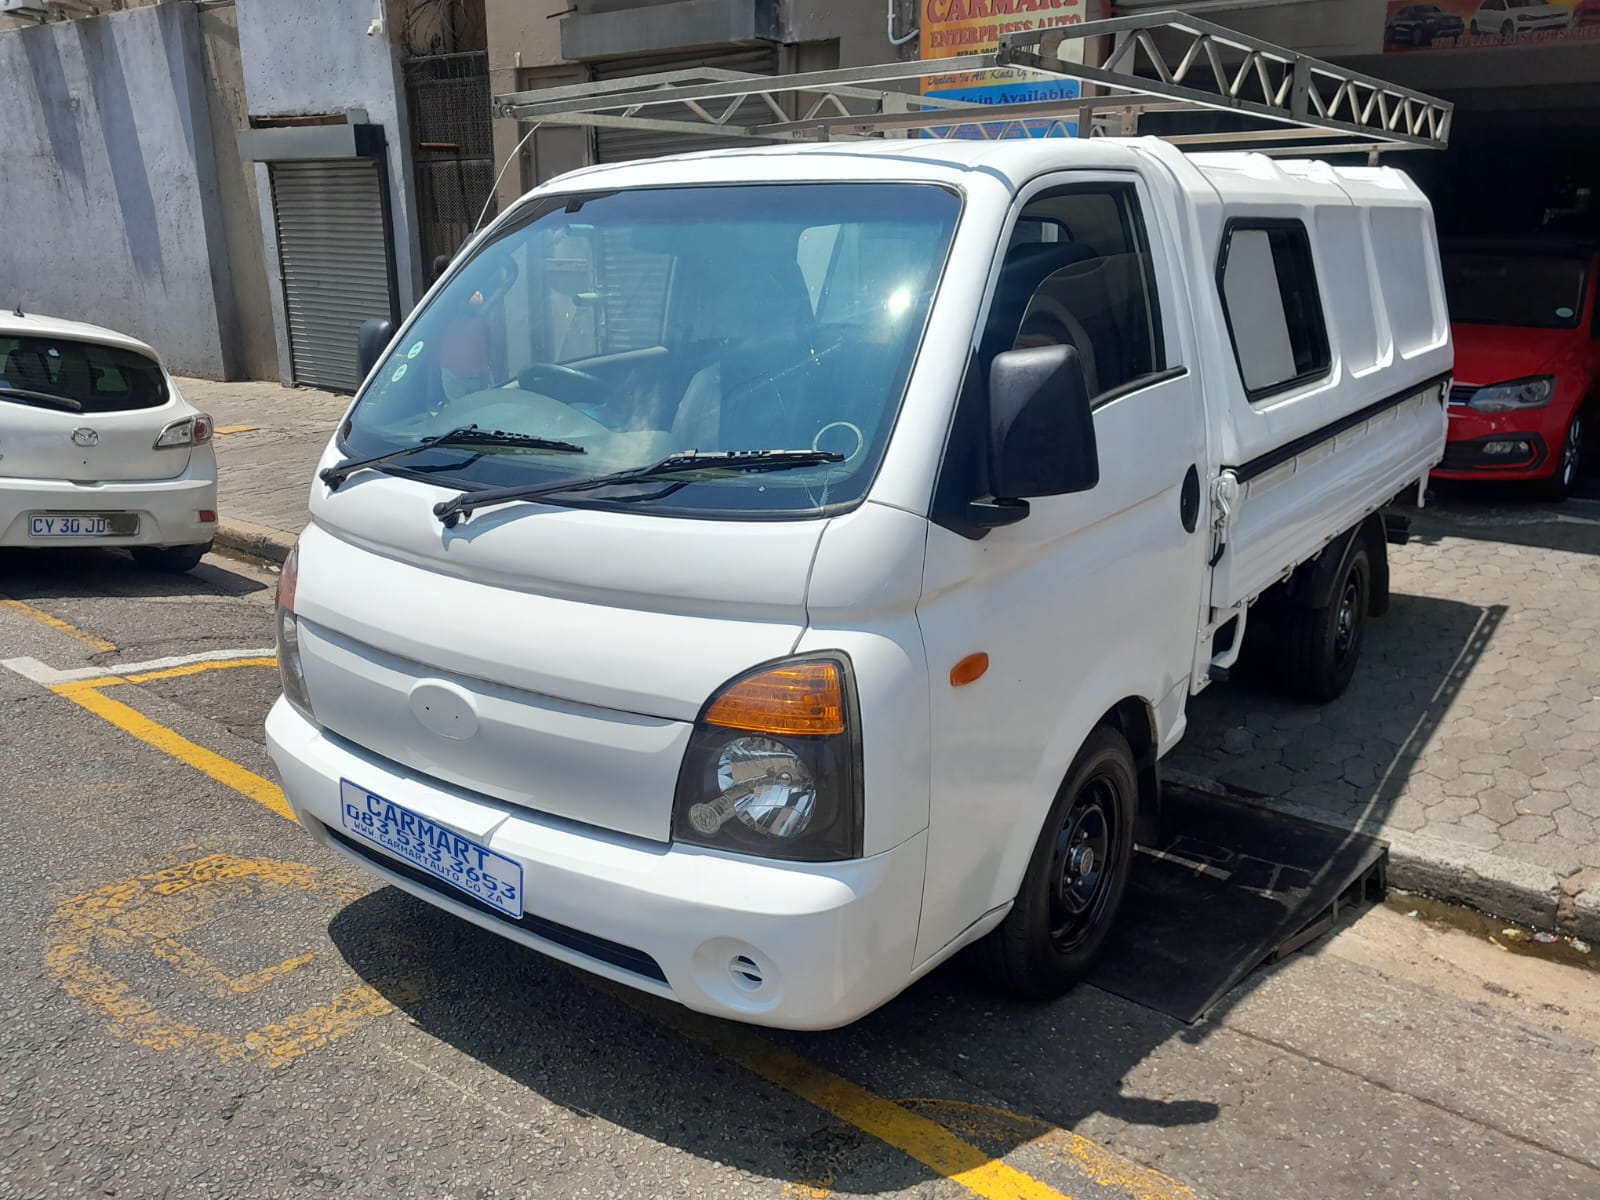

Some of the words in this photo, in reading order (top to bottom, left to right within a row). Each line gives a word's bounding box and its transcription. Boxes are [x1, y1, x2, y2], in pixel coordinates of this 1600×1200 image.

[927, 0, 1079, 23] CARMAR
[999, 88, 1074, 105] Available
[33, 518, 55, 533] CY
[60, 518, 80, 533] 30
[85, 518, 106, 533] JD
[346, 803, 390, 834] 083
[396, 829, 442, 862] 533
[450, 856, 516, 900] 3653
[366, 795, 490, 871] CARMART
[353, 820, 504, 905] WWW.CARMARTAUTO.CO.ZA
